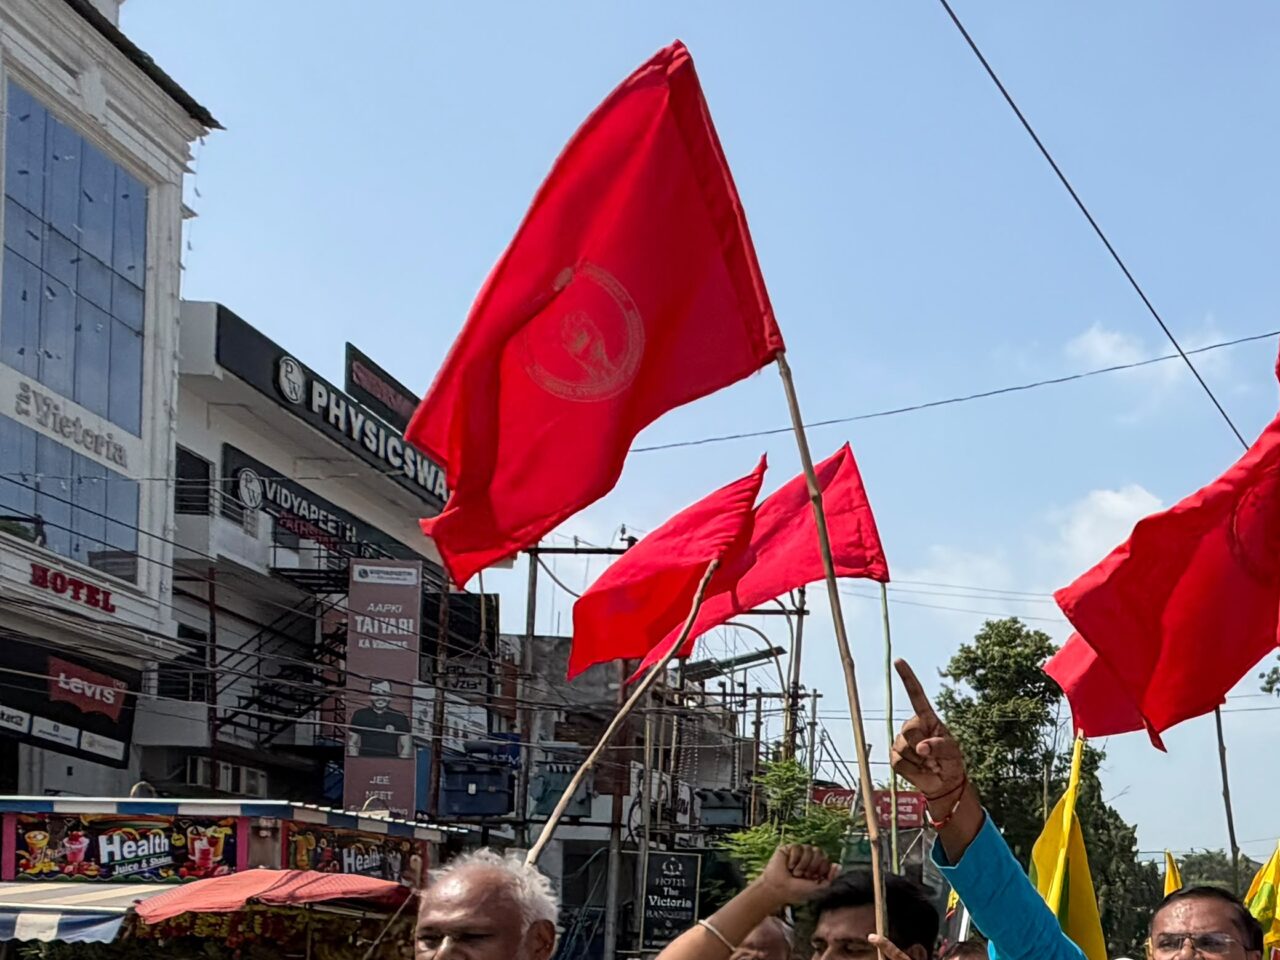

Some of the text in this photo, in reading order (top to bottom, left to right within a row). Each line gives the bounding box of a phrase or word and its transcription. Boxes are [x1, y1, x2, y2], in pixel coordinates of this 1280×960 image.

[311, 380, 447, 490] PHYSICSWA
[264, 478, 357, 543] VIDYAPEETH
[30, 563, 115, 613] HOTEL
[355, 616, 413, 635] TAIYARI
[369, 776, 390, 784] JEE
[99, 834, 170, 863] Health
[112, 862, 139, 875] Juice
[648, 895, 692, 908] Victoria
